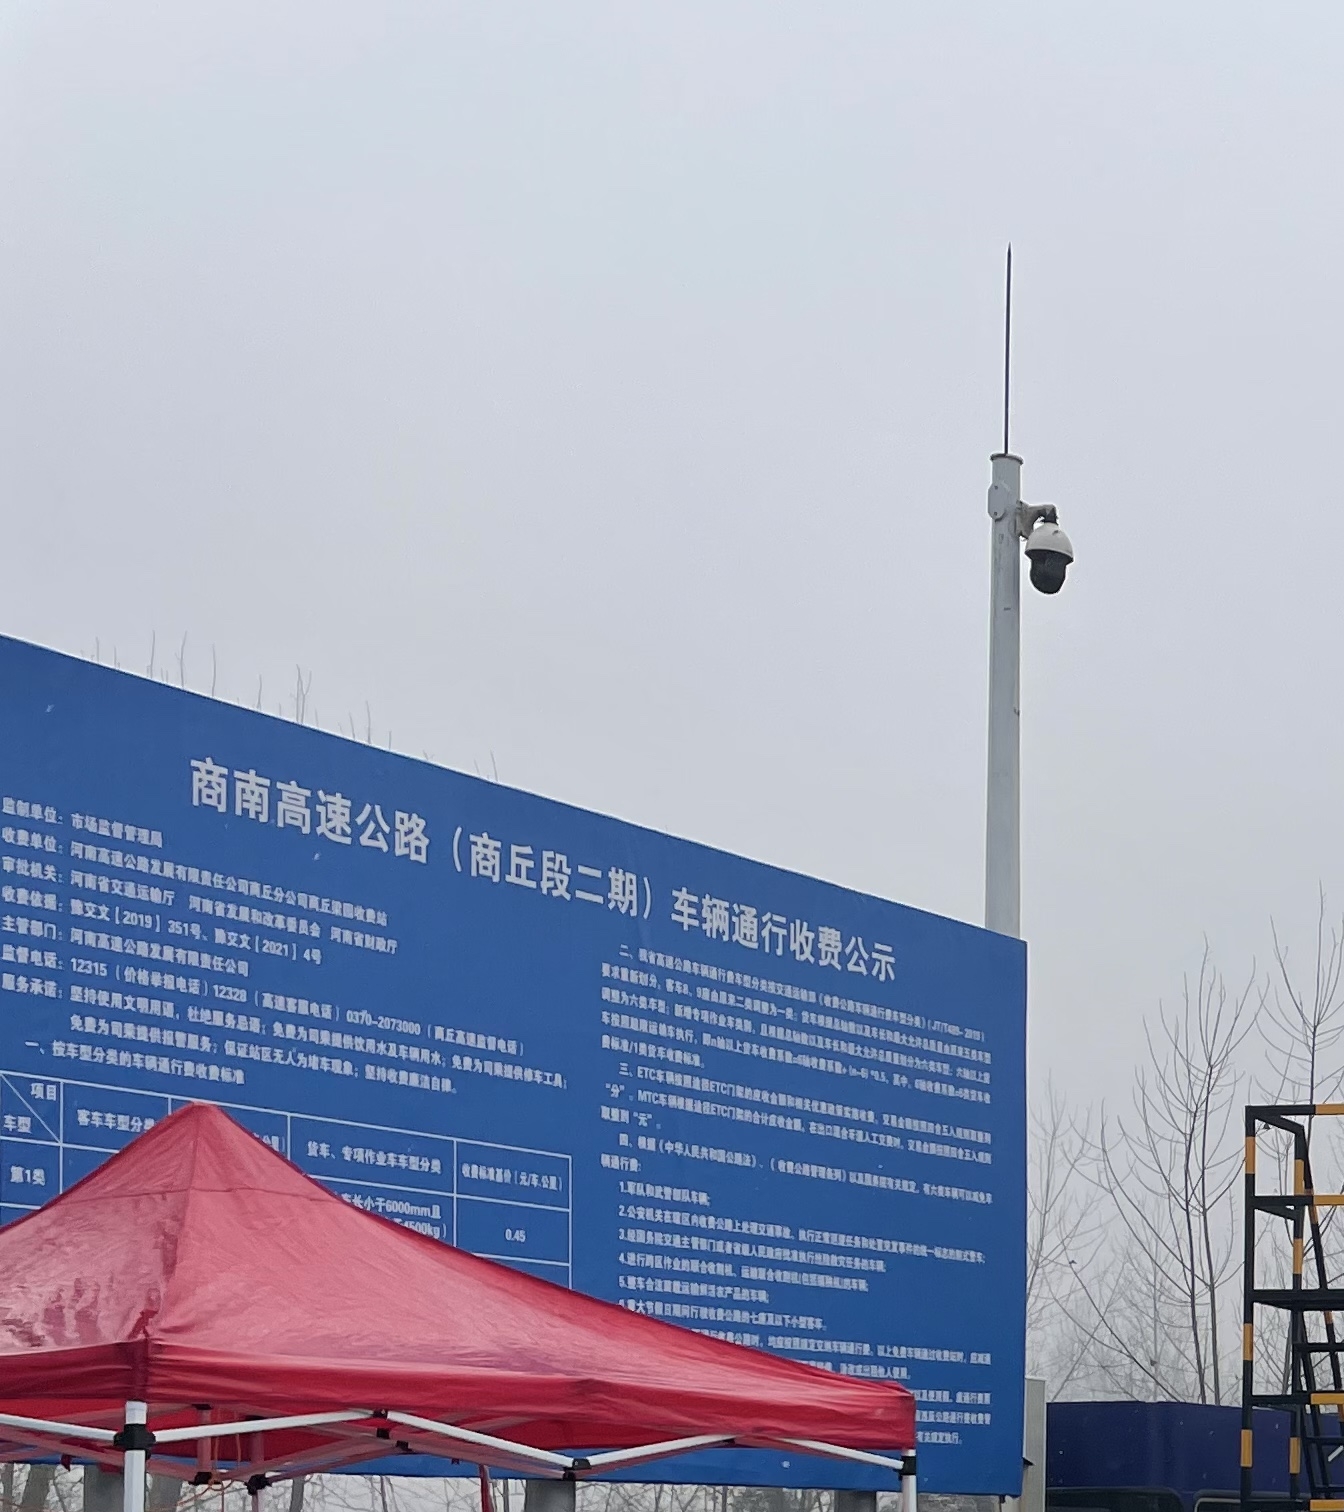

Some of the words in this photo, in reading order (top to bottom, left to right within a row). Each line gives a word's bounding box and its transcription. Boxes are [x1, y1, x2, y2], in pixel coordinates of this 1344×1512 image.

[31, 1082, 57, 1101] 项目
[3, 1113, 32, 1134] 车型
[10, 1165, 45, 1186] 第1类
